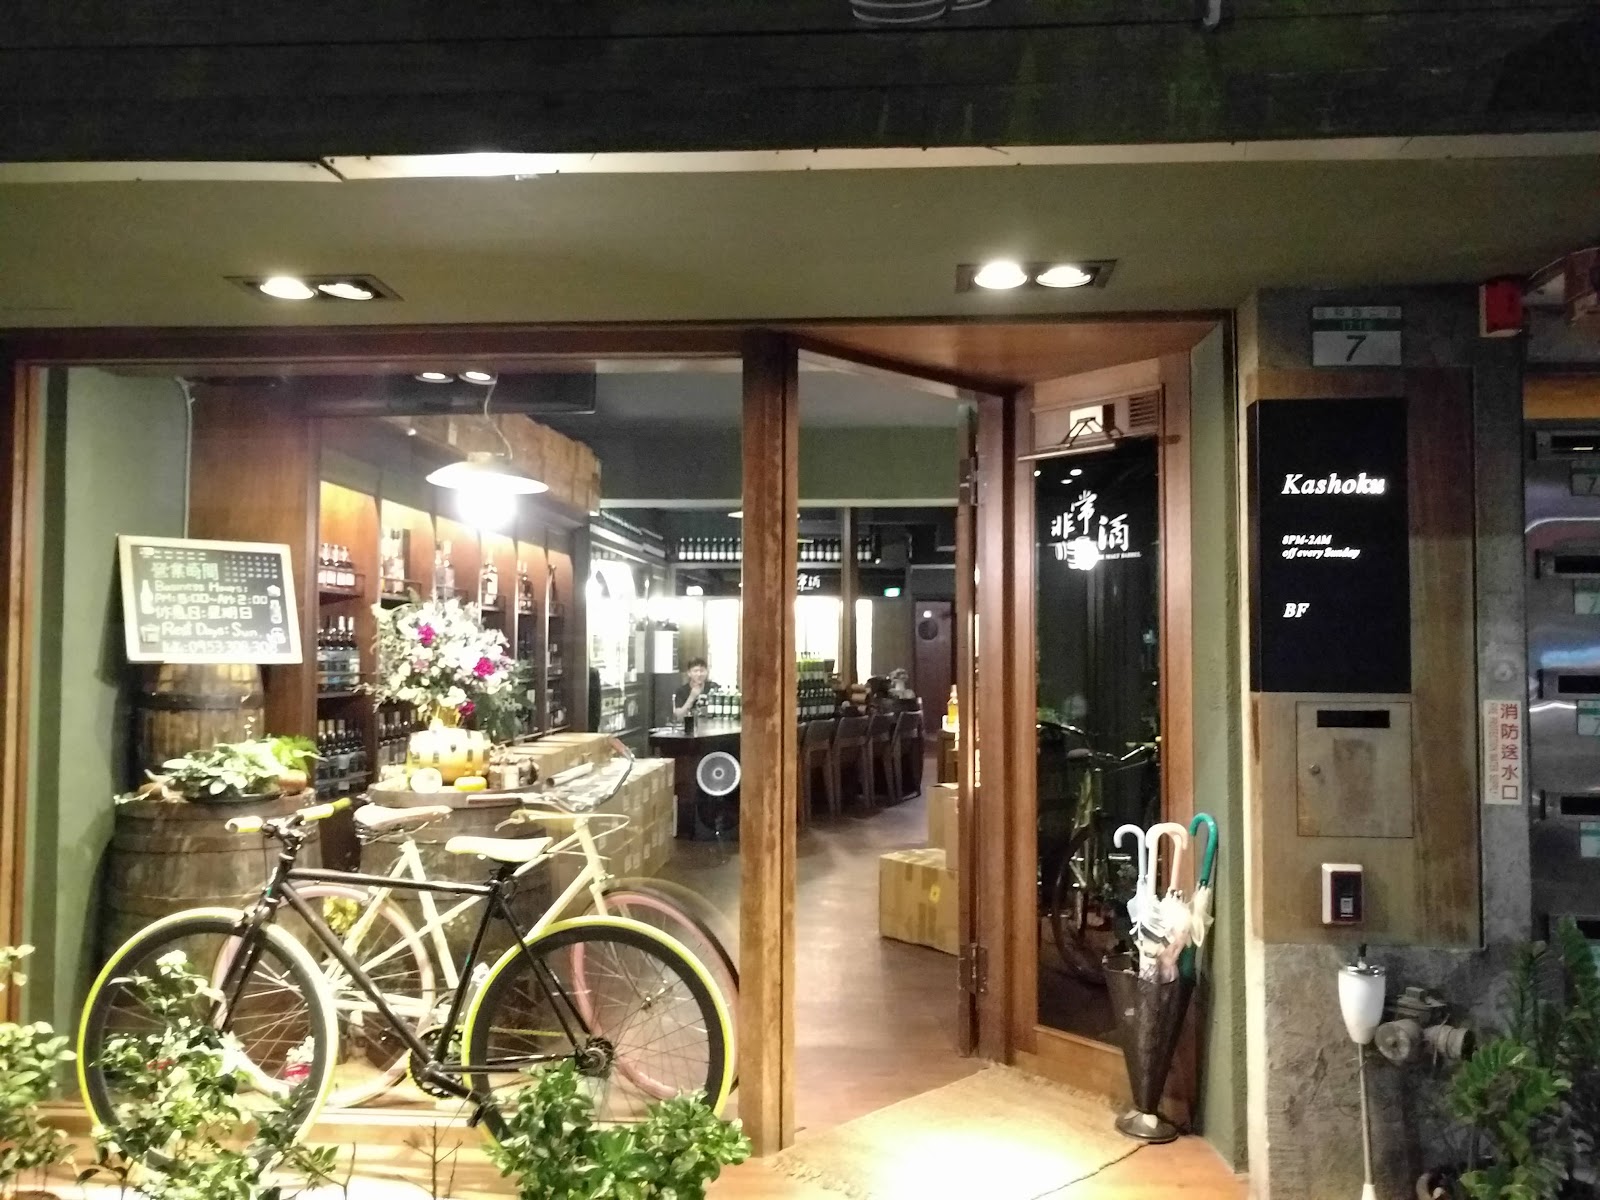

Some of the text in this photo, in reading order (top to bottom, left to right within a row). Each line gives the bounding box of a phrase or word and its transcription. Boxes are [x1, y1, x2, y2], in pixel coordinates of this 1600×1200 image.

[1346, 335, 1367, 362] 7
[1281, 472, 1386, 495] Kashoku
[1281, 534, 1333, 545] 8PM-2AM
[1282, 547, 1361, 560] off every Sunday
[1282, 603, 1310, 618] BF
[1500, 702, 1519, 800] 消防送水口
